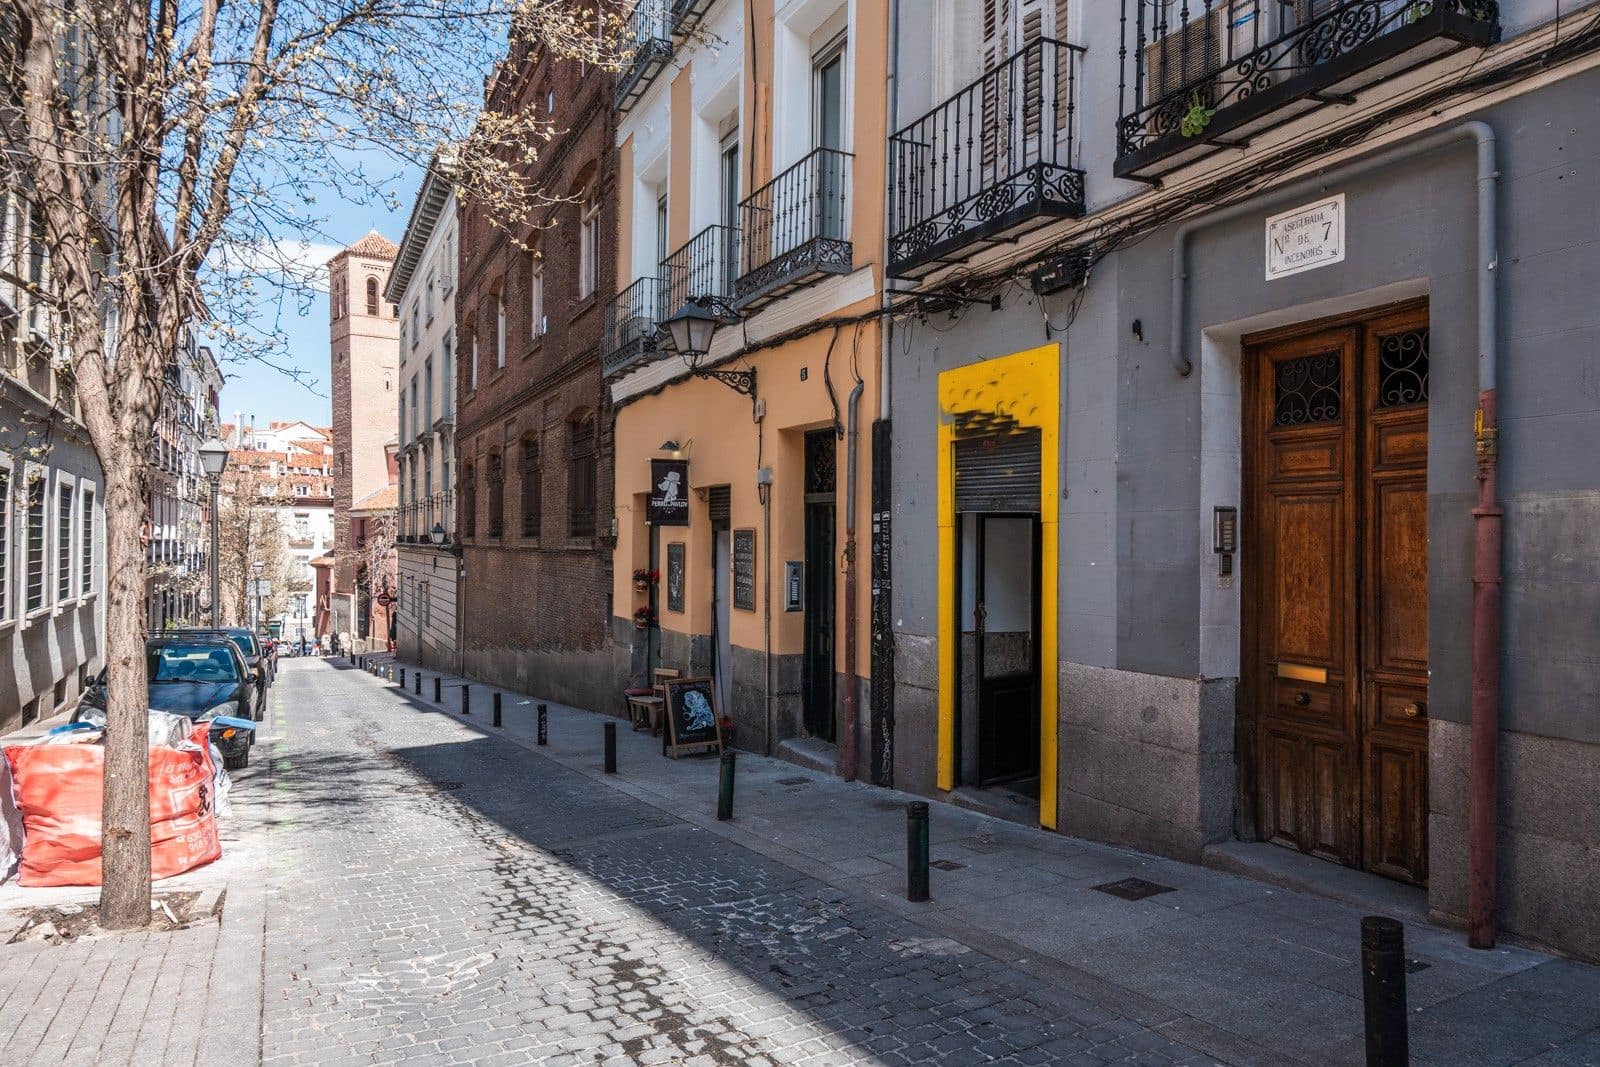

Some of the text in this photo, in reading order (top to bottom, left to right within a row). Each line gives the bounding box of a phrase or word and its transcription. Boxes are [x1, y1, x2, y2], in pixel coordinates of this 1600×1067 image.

[1284, 212, 1324, 232] ASEGURADA
[1297, 233, 1310, 245] DE
[1322, 221, 1332, 242] 7
[1284, 246, 1323, 264] INCENDIOS
